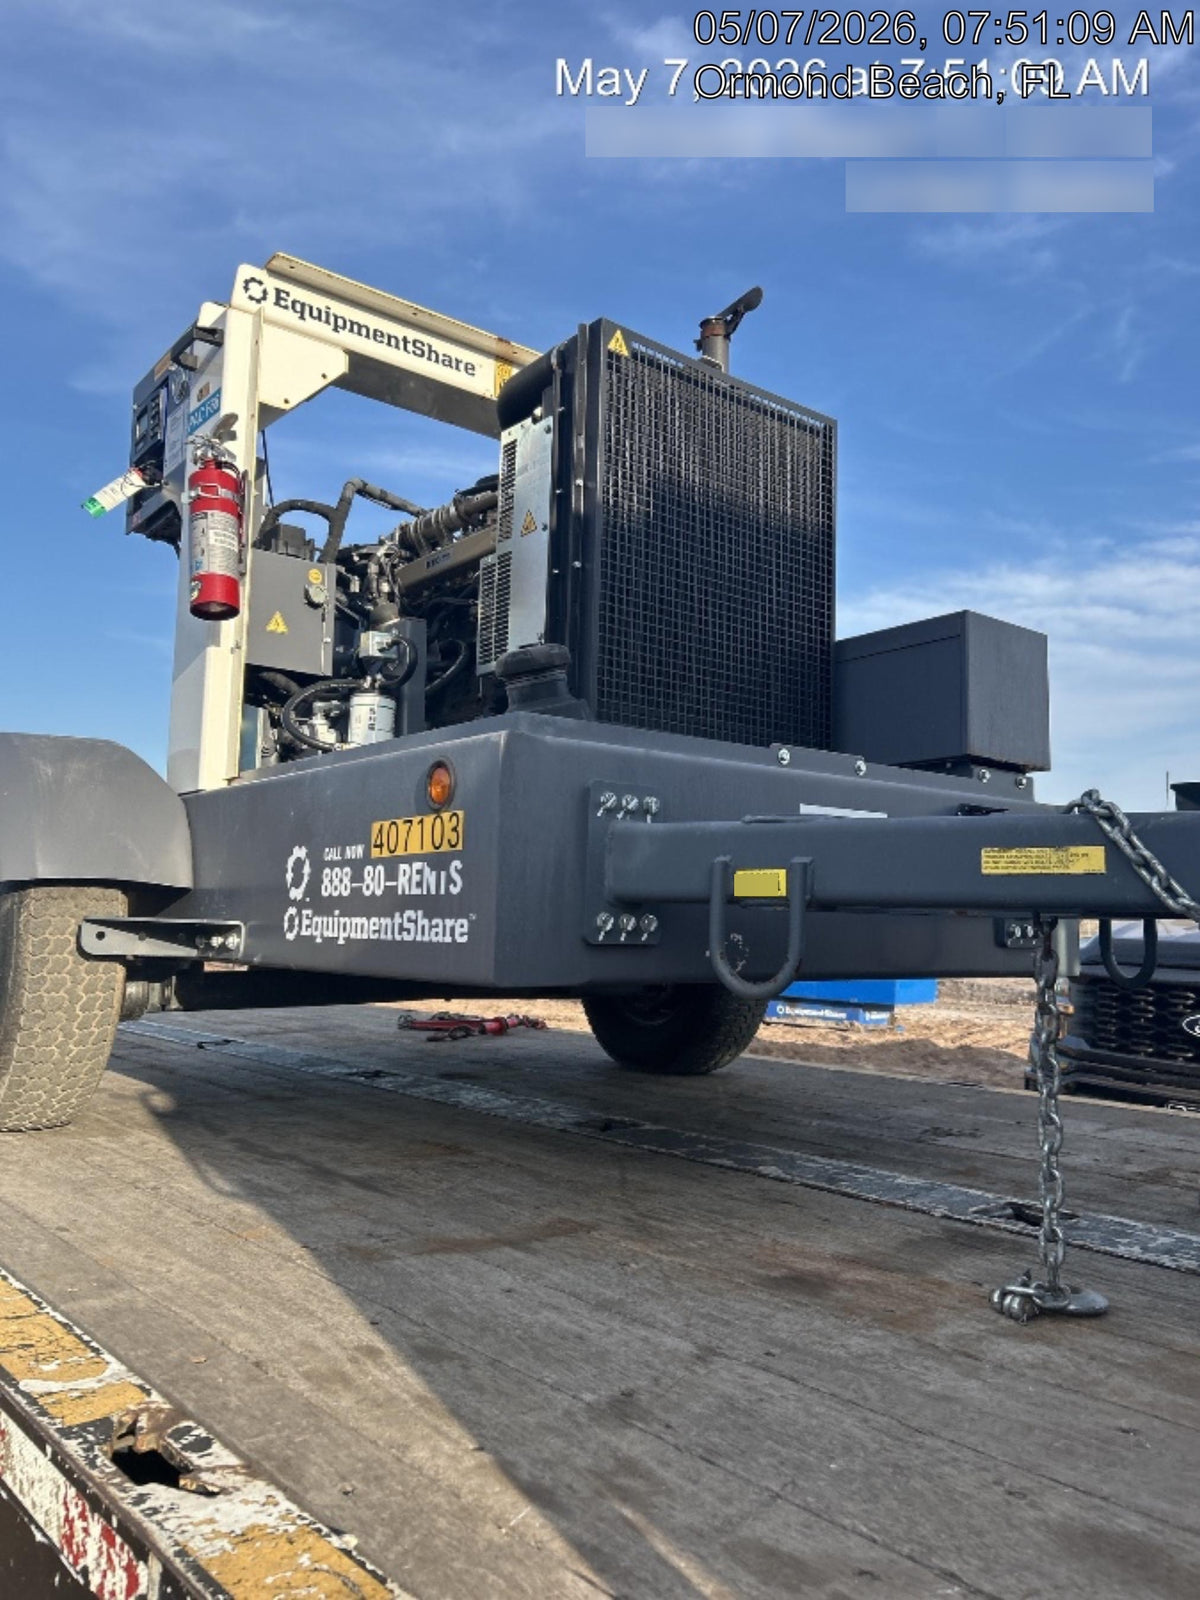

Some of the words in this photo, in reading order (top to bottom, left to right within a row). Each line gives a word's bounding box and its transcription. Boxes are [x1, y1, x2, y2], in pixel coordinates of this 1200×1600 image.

[273, 287, 477, 377] EquipmentShare
[323, 846, 343, 862] CALL
[344, 844, 365, 860] NOW
[373, 812, 460, 855] 407103
[300, 909, 469, 944] EquipmentShare
